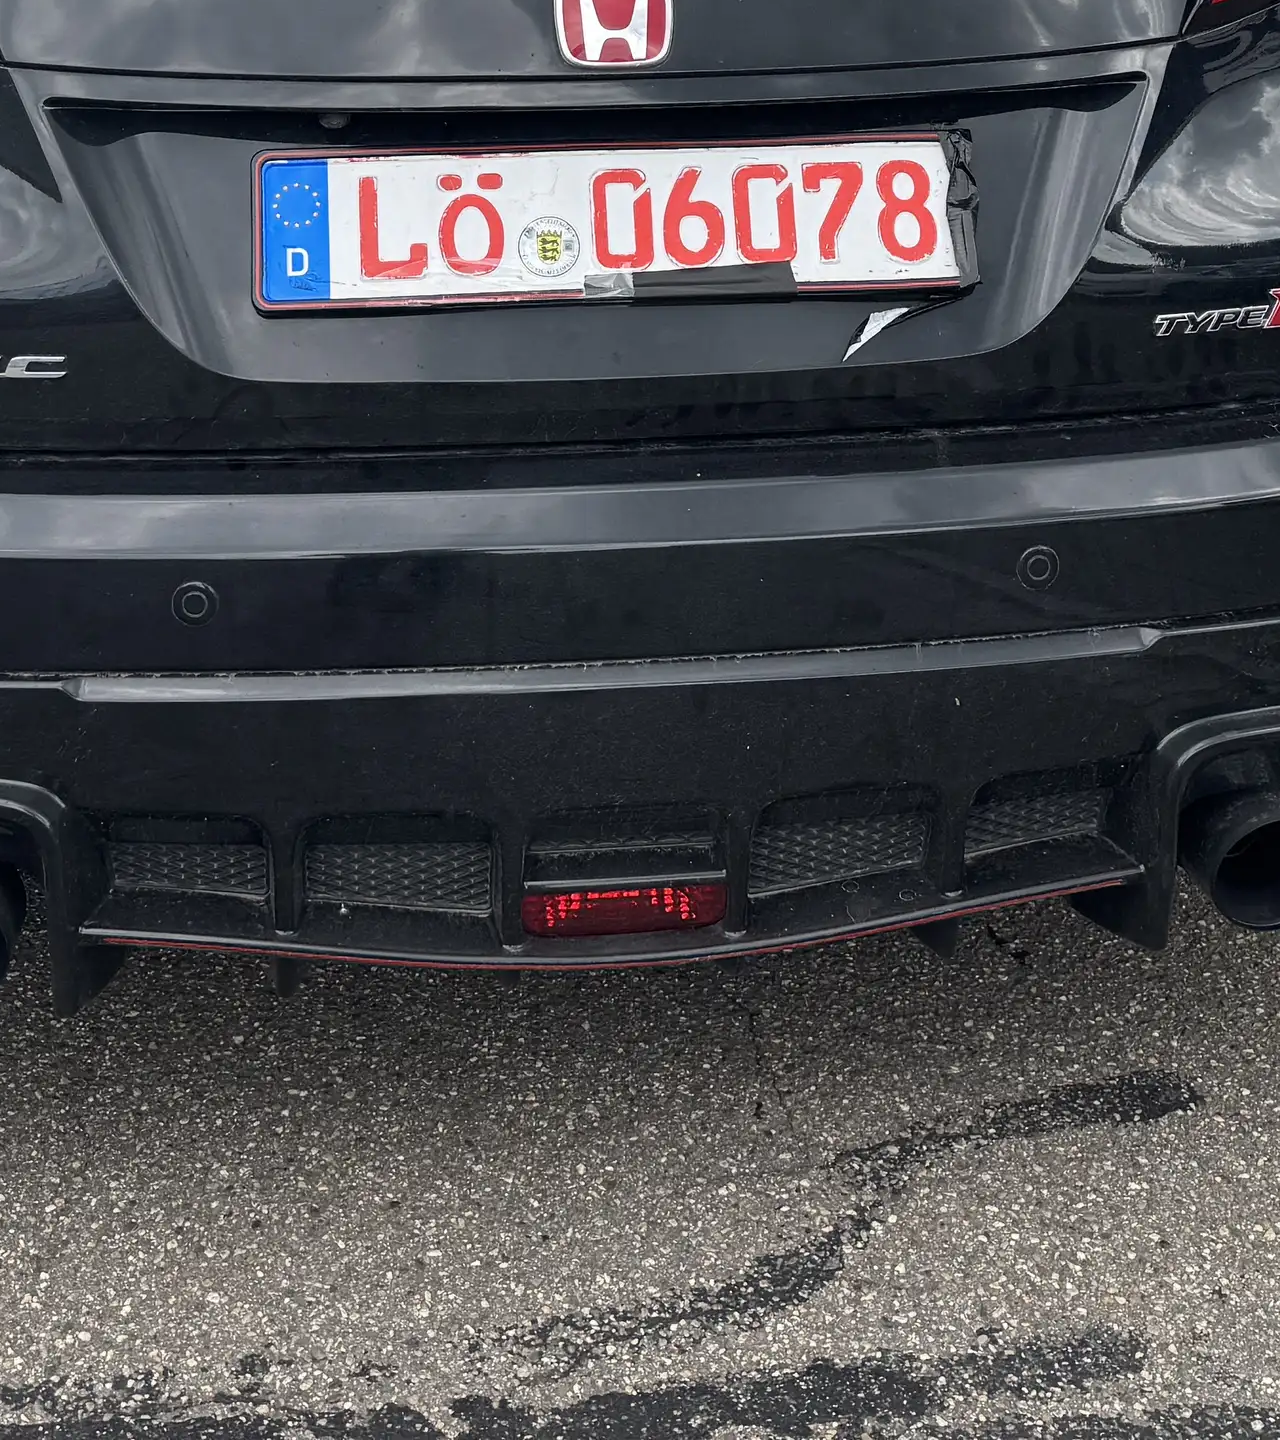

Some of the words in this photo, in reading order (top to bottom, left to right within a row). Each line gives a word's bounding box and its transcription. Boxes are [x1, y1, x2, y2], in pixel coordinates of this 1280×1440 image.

[286, 247, 310, 277] D
[358, 172, 505, 281] LÖ
[589, 159, 938, 271] 06078
